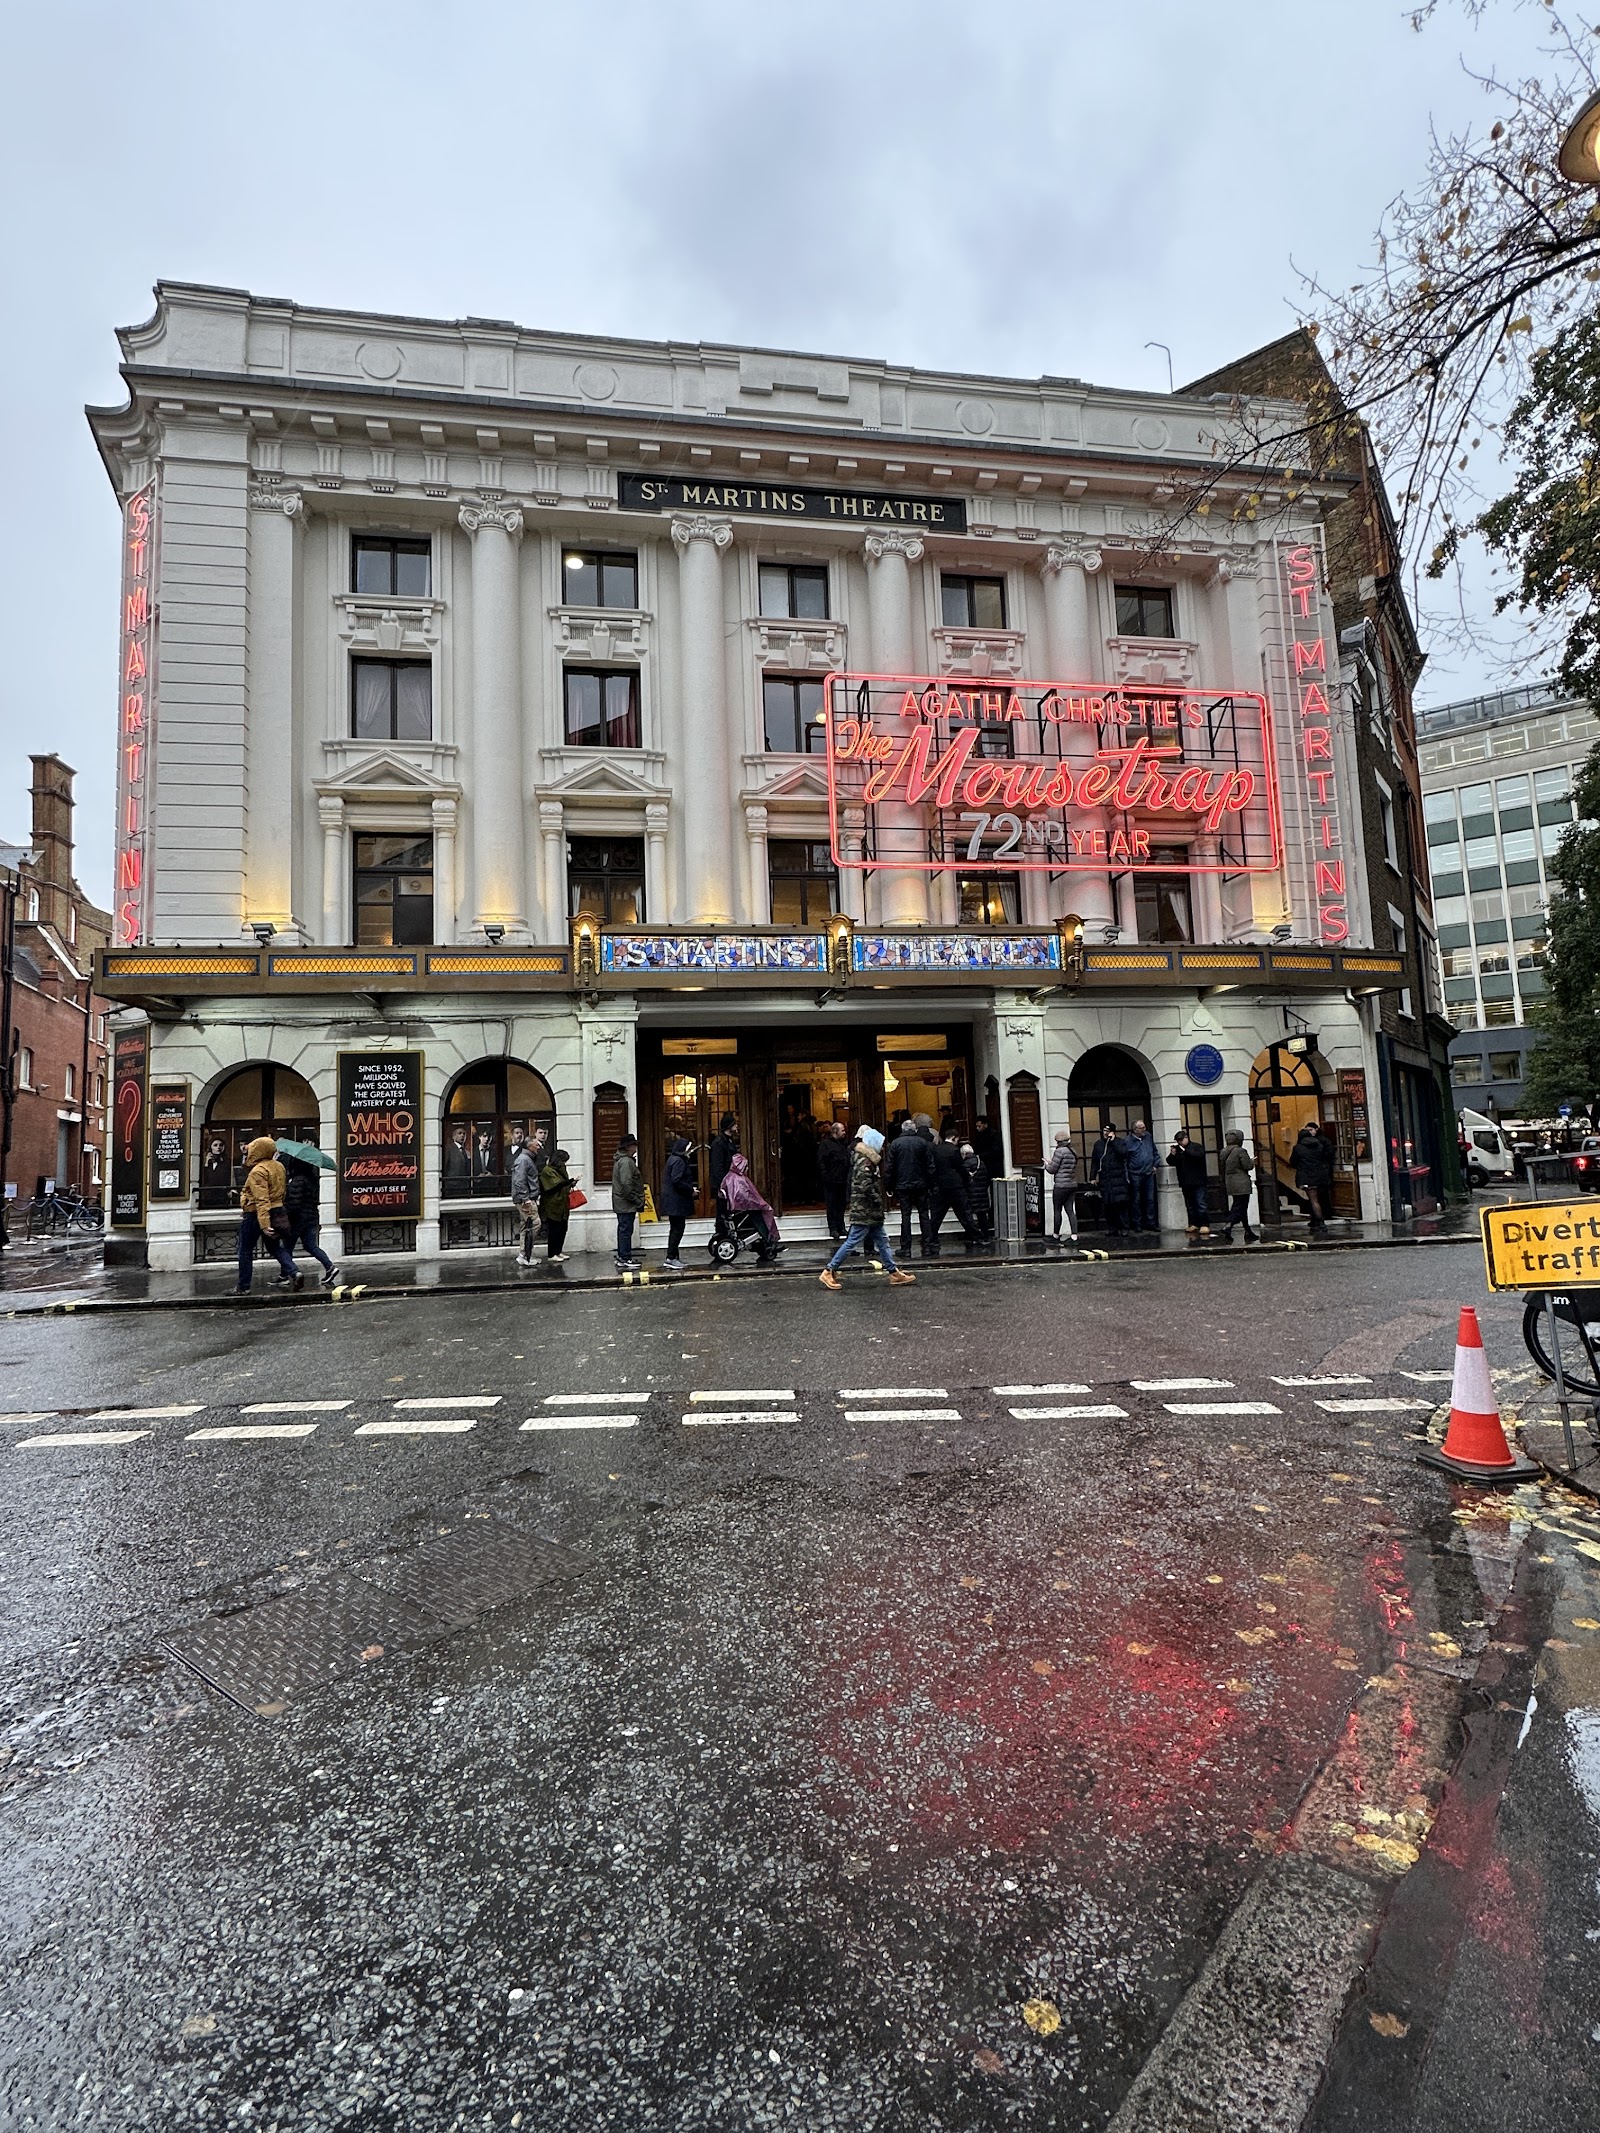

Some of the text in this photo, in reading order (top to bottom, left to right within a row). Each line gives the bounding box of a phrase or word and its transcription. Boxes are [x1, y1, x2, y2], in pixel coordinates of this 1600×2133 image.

[681, 484, 806, 511] MARTINS
[824, 496, 945, 522] THEATRE
[900, 690, 1204, 728] AGATHA CHRISTIE'S
[835, 720, 894, 760] The
[1288, 547, 1349, 942] ST MARTINS
[120, 586, 148, 943] MARTINS
[863, 725, 1256, 832] Mousetrap
[959, 812, 1151, 861] 72ND YEAR
[888, 940, 1026, 964] THEATRE
[358, 1065, 405, 1073] SINCE 1952,
[362, 1073, 398, 1081] MILLIONS
[354, 1082, 375, 1090] HAVE
[370, 1090, 406, 1098] GREATEST
[347, 1110, 414, 1132] WHO
[347, 1132, 414, 1146] DUNNIT?
[343, 1161, 418, 1178] Mousetrap
[1025, 1184, 1040, 1195] OFFICE
[1026, 1175, 1037, 1185] BOX
[352, 1193, 409, 1206] SOLVE IT.
[1025, 1193, 1039, 1204] NOW
[1521, 1245, 1600, 1271] traff
